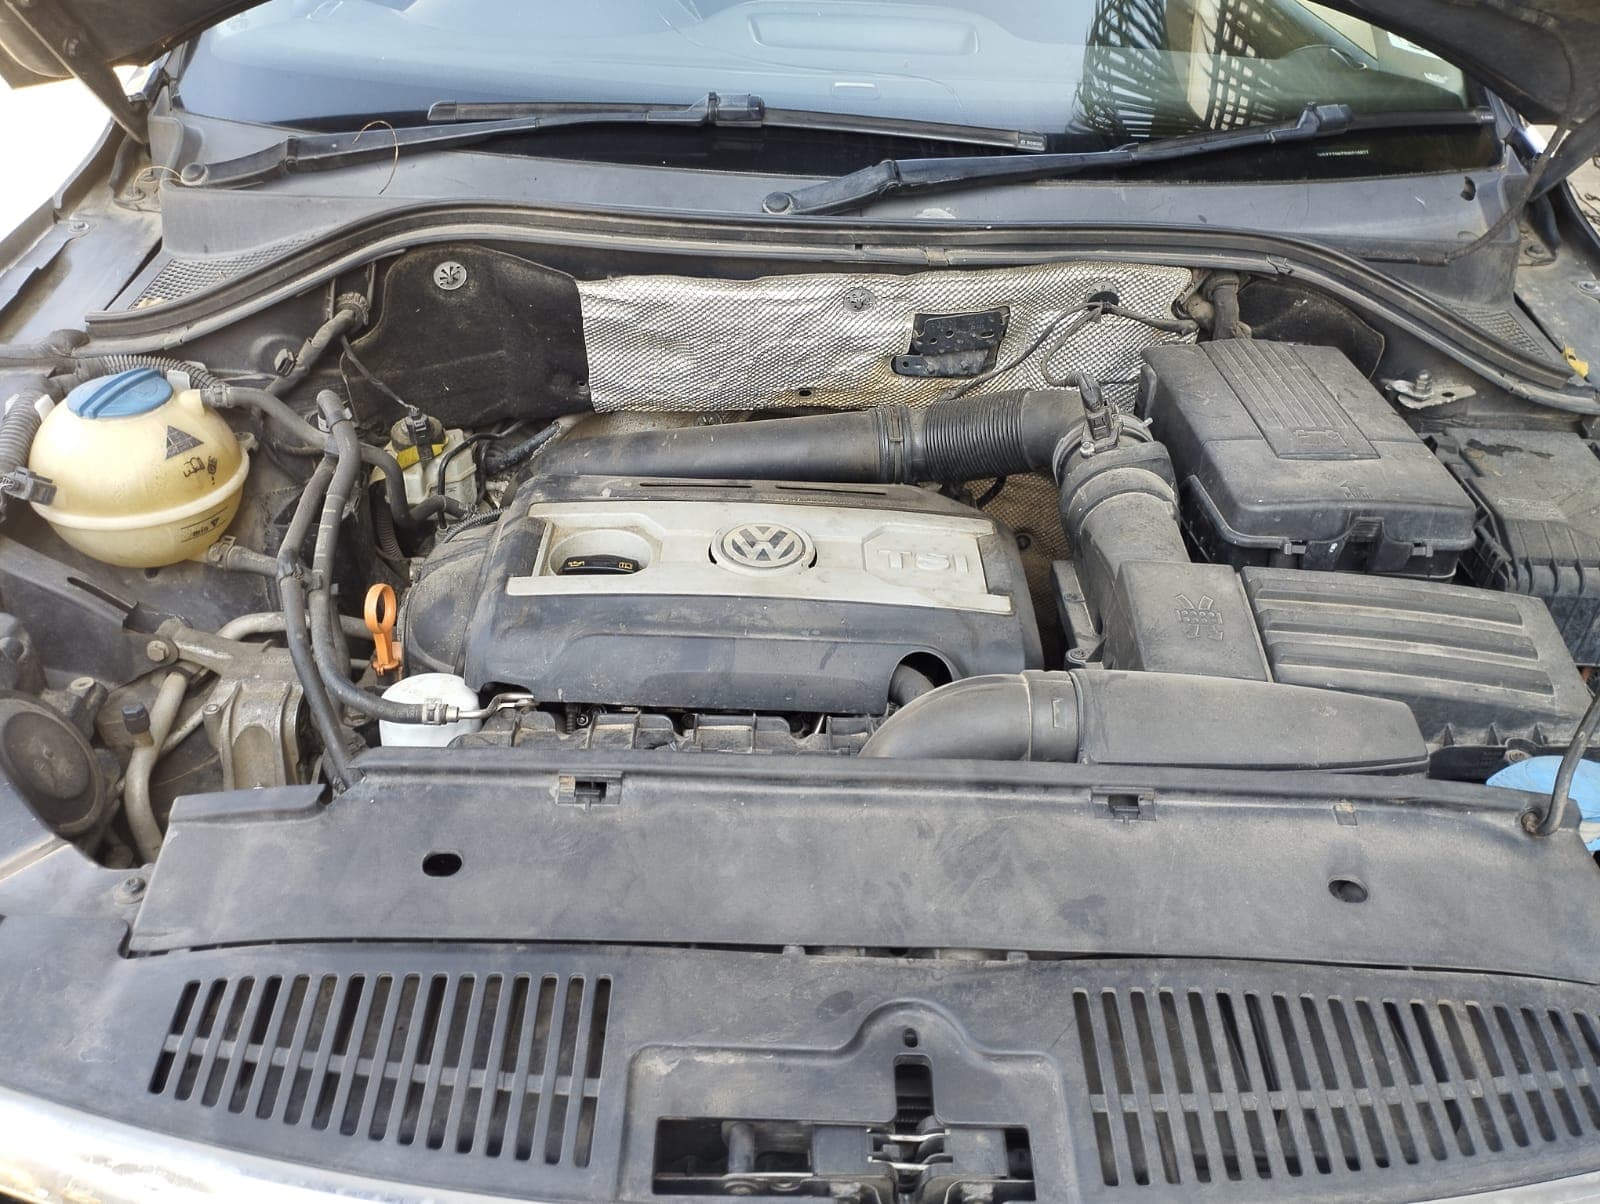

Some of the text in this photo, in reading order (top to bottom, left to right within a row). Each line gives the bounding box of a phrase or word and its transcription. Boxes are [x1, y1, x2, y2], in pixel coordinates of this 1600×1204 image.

[193, 526, 209, 537] min
[724, 524, 801, 567] VW
[877, 548, 970, 574] TSI
